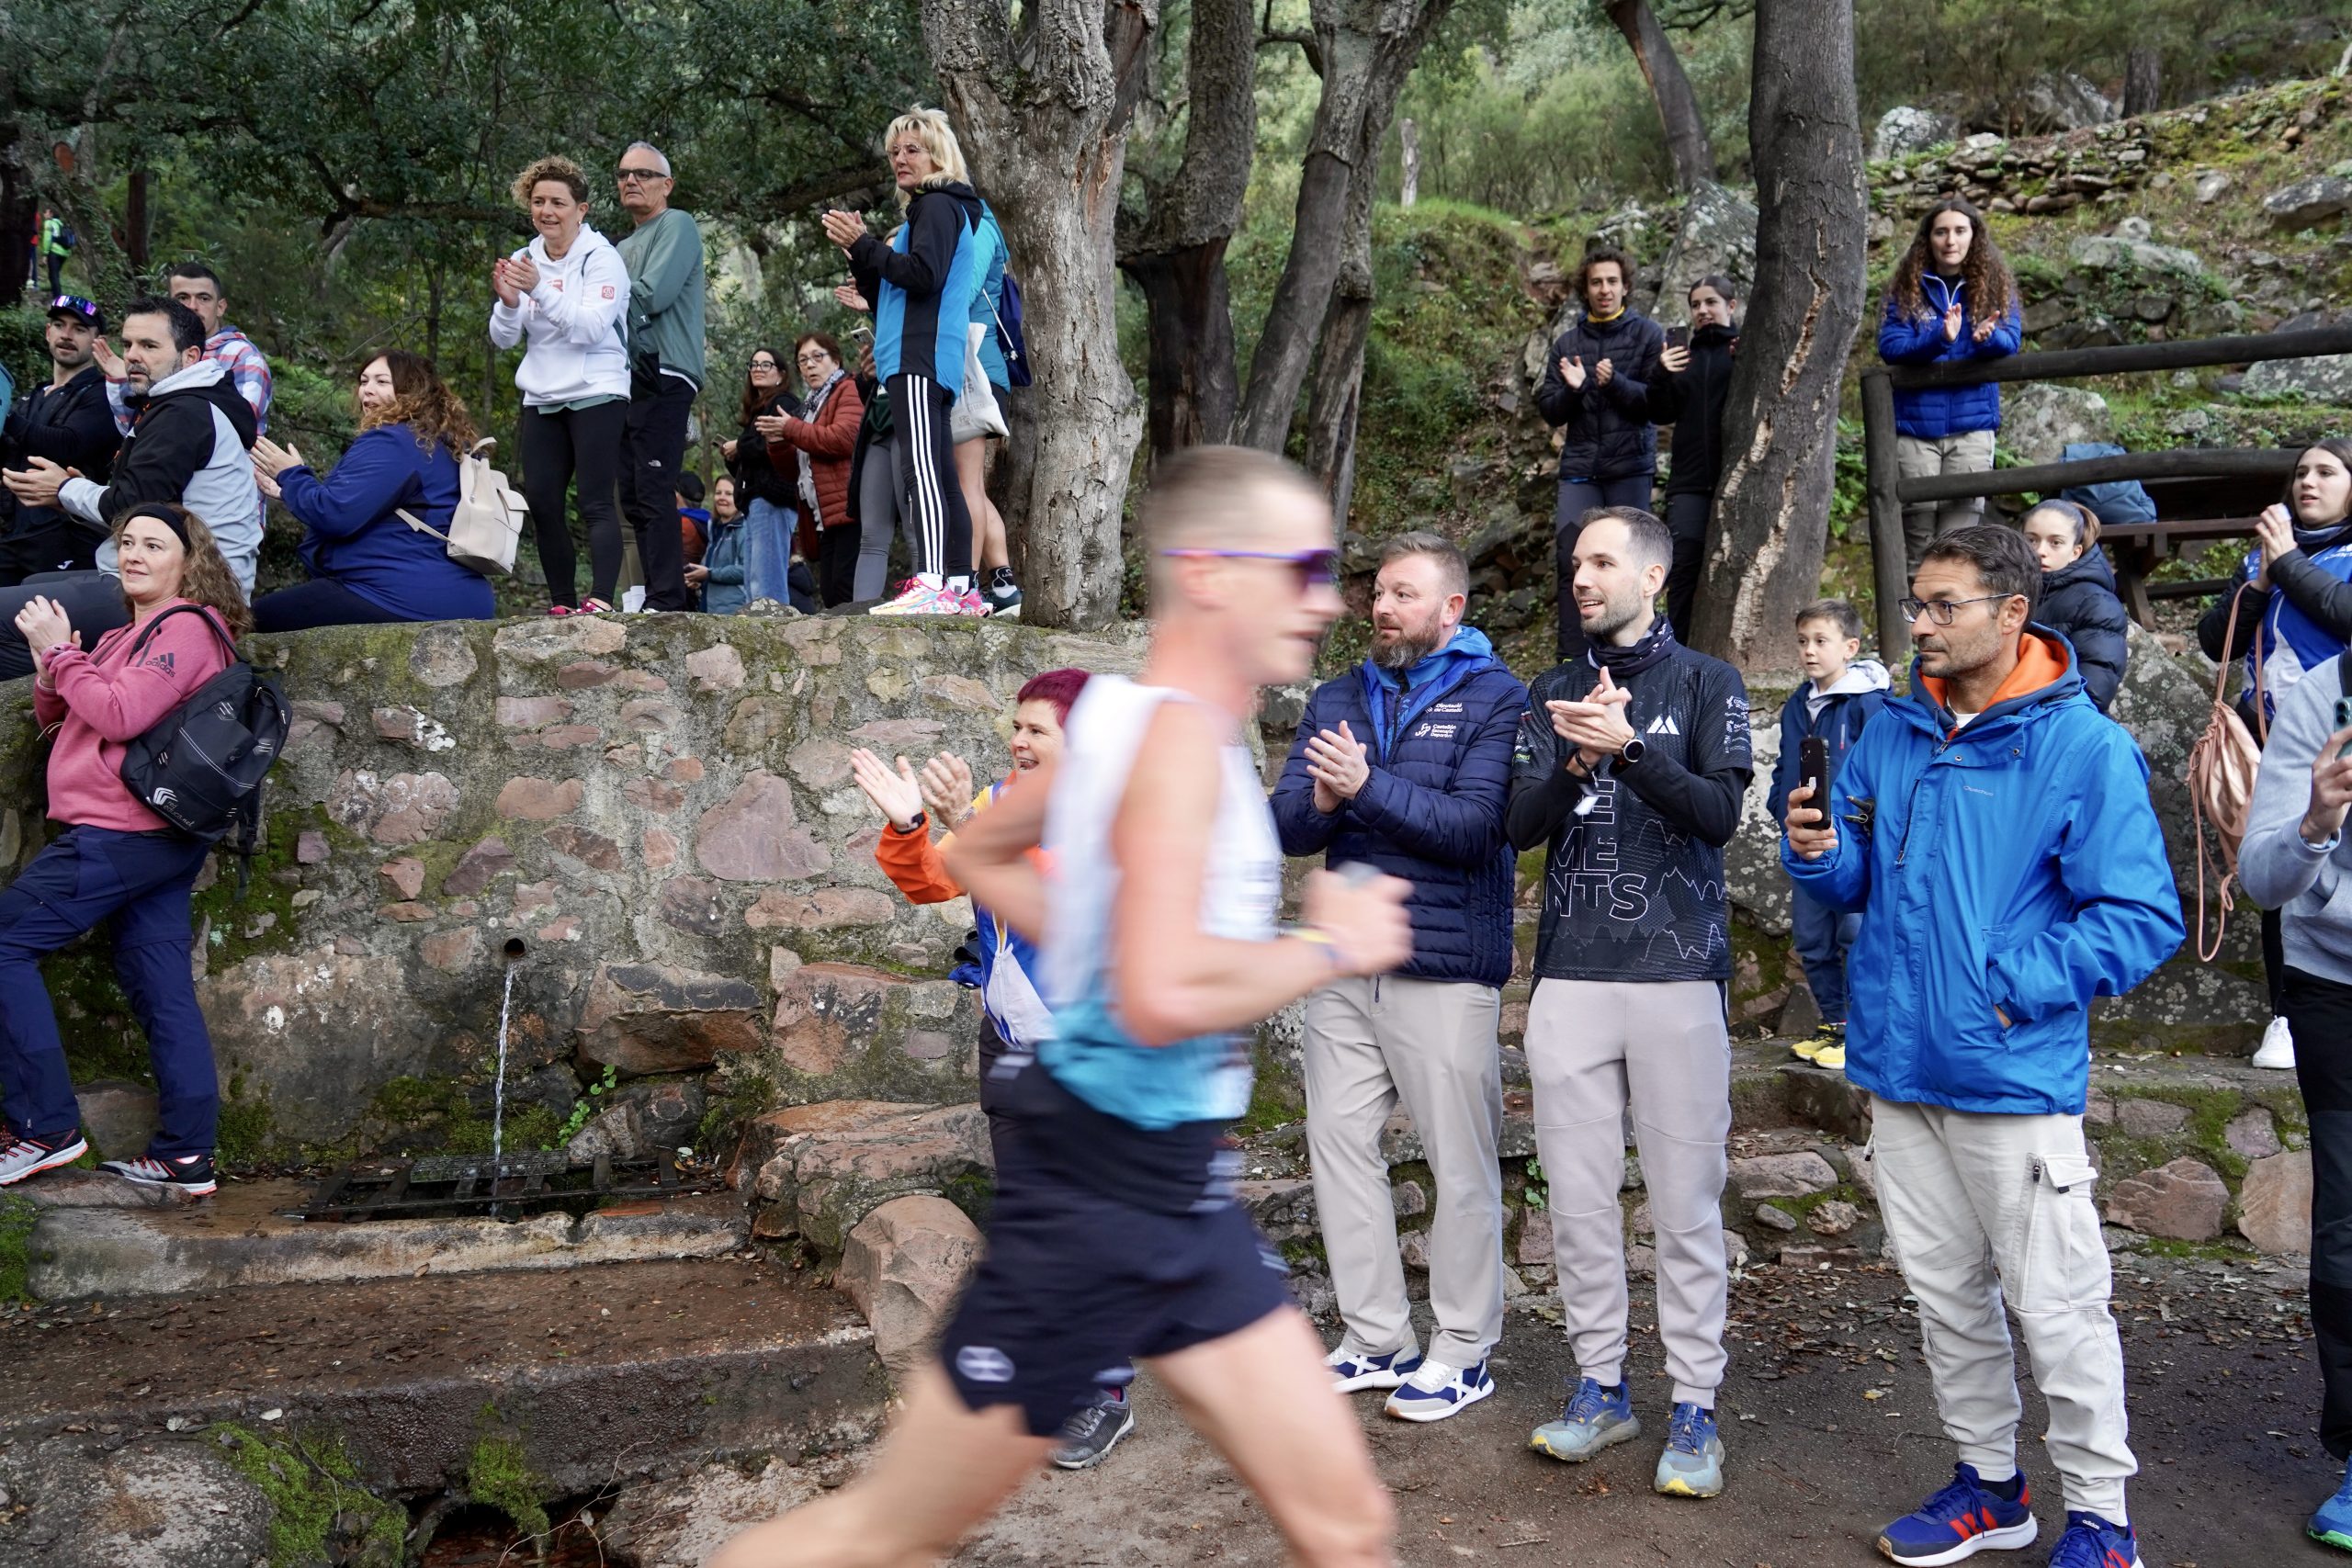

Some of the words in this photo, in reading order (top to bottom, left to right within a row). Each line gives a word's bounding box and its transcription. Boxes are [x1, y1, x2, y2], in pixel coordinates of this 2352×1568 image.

[145, 660, 176, 678] adidas
[1550, 826, 1619, 872] ME
[1545, 873, 1648, 921] NTS
[2082, 1519, 2100, 1530] adidas
